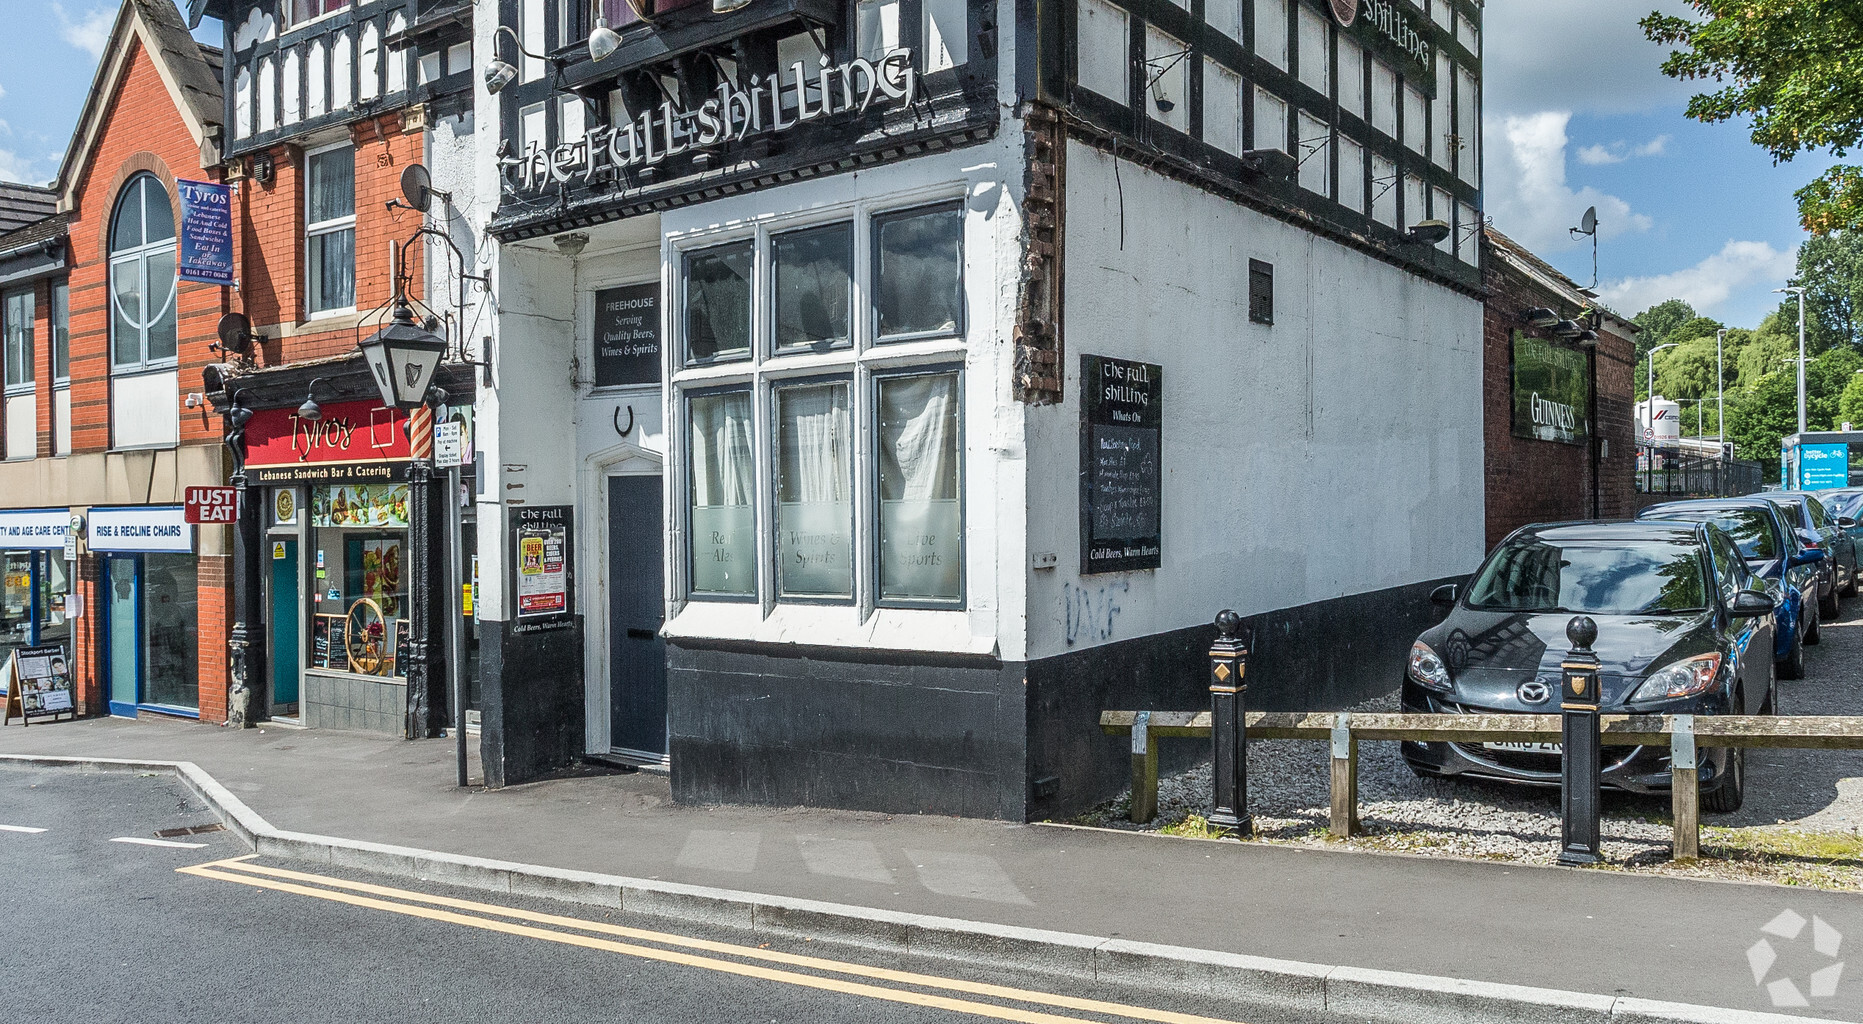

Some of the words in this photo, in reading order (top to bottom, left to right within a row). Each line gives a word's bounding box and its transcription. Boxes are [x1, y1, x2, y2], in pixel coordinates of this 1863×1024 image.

[184, 185, 227, 205] Tyros
[193, 211, 221, 220] Lebanese
[187, 217, 199, 225] Hot
[200, 219, 213, 227] And
[213, 221, 228, 229] Cold
[186, 225, 203, 233] Food
[203, 227, 221, 236] Boxes
[189, 233, 224, 244] Sandwiches
[194, 242, 209, 251] Eat
[211, 244, 220, 253] In
[187, 256, 227, 269] Takeaway
[185, 268, 200, 276] 0161
[201, 270, 213, 278] 477
[605, 297, 654, 312] FREEHOUSE
[615, 314, 643, 327] Serving
[603, 330, 632, 344] Quality
[632, 329, 656, 339] Beers,
[601, 346, 623, 357] Wines
[624, 345, 631, 356] &
[632, 343, 659, 357] Spirits
[1112, 409, 1132, 422] Whats
[1132, 411, 1141, 423] On
[1531, 391, 1575, 430] GUINNESS
[288, 413, 357, 462] Tyros
[259, 470, 292, 481] Lebanese
[294, 468, 329, 480] Sandwich
[331, 467, 345, 477] Bar
[347, 466, 353, 476] &
[355, 465, 391, 477] Catering
[188, 489, 234, 505] JUST
[200, 505, 233, 521] EAT
[8, 526, 21, 536] AND
[22, 525, 34, 536] AGE
[35, 525, 51, 536] CARE
[96, 526, 112, 537] RISE
[113, 525, 119, 537] &
[120, 525, 151, 537] RECLINE
[153, 525, 182, 537] CHAIRS
[526, 543, 542, 552] BEER
[1090, 548, 1105, 560] Cold
[1105, 548, 1122, 559] Beers,
[1124, 547, 1140, 557] Warm
[1141, 545, 1159, 556] Hearts
[513, 624, 526, 633] Cold
[527, 622, 541, 631] Beers,
[542, 621, 556, 629] Warm
[557, 619, 573, 628] Hearts
